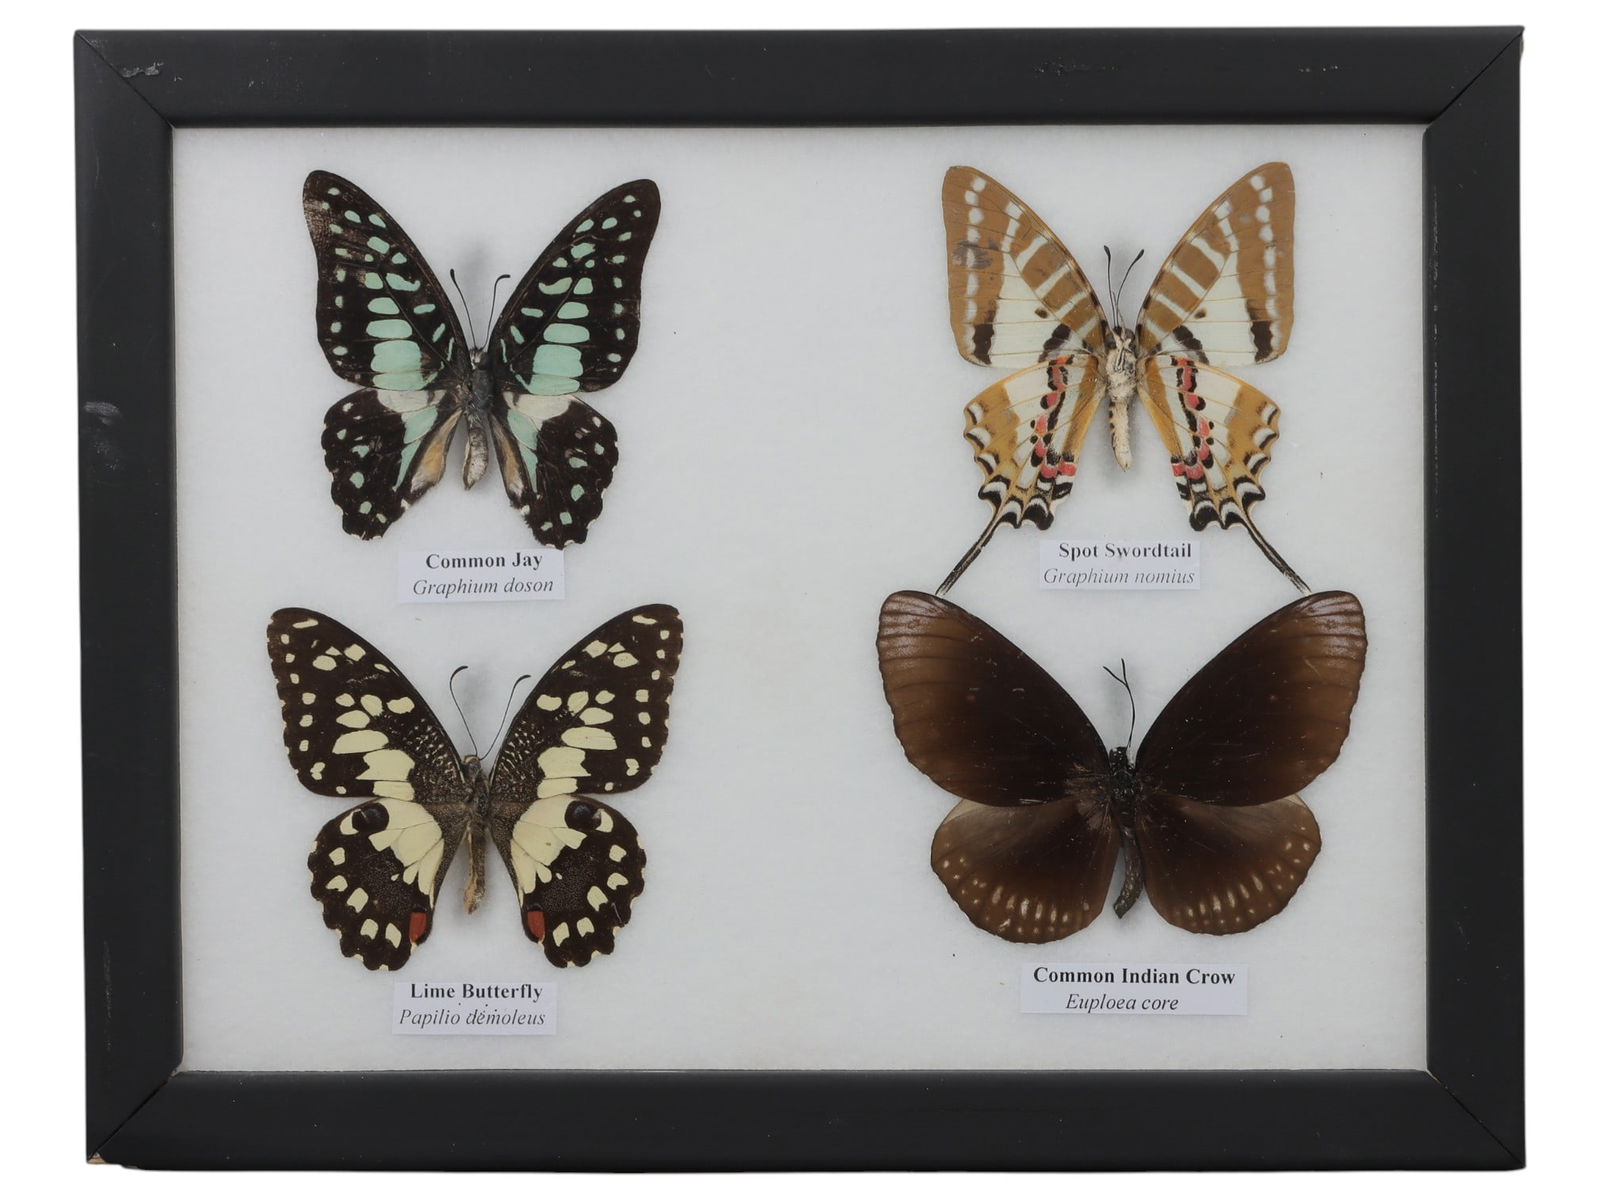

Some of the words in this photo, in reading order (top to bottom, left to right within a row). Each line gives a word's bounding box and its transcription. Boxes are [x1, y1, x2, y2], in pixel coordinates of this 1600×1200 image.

[425, 553, 506, 569] Common
[511, 553, 543, 571] Jay
[1058, 543, 1098, 562] Spot
[1104, 542, 1193, 559] Swordtail
[413, 578, 498, 599] Graphium
[503, 577, 554, 593] doson
[1043, 568, 1129, 588] Graphium
[1134, 569, 1195, 585] nomius
[1033, 966, 1115, 984] Common
[1121, 967, 1180, 984] Indian
[1185, 968, 1236, 985] Crow
[410, 983, 456, 999] Lime
[462, 983, 543, 1004] Butterfly
[1065, 993, 1137, 1014] Euploea
[1141, 997, 1179, 1011] core
[399, 1008, 461, 1029] Papilio
[465, 1008, 546, 1026] demoleus
